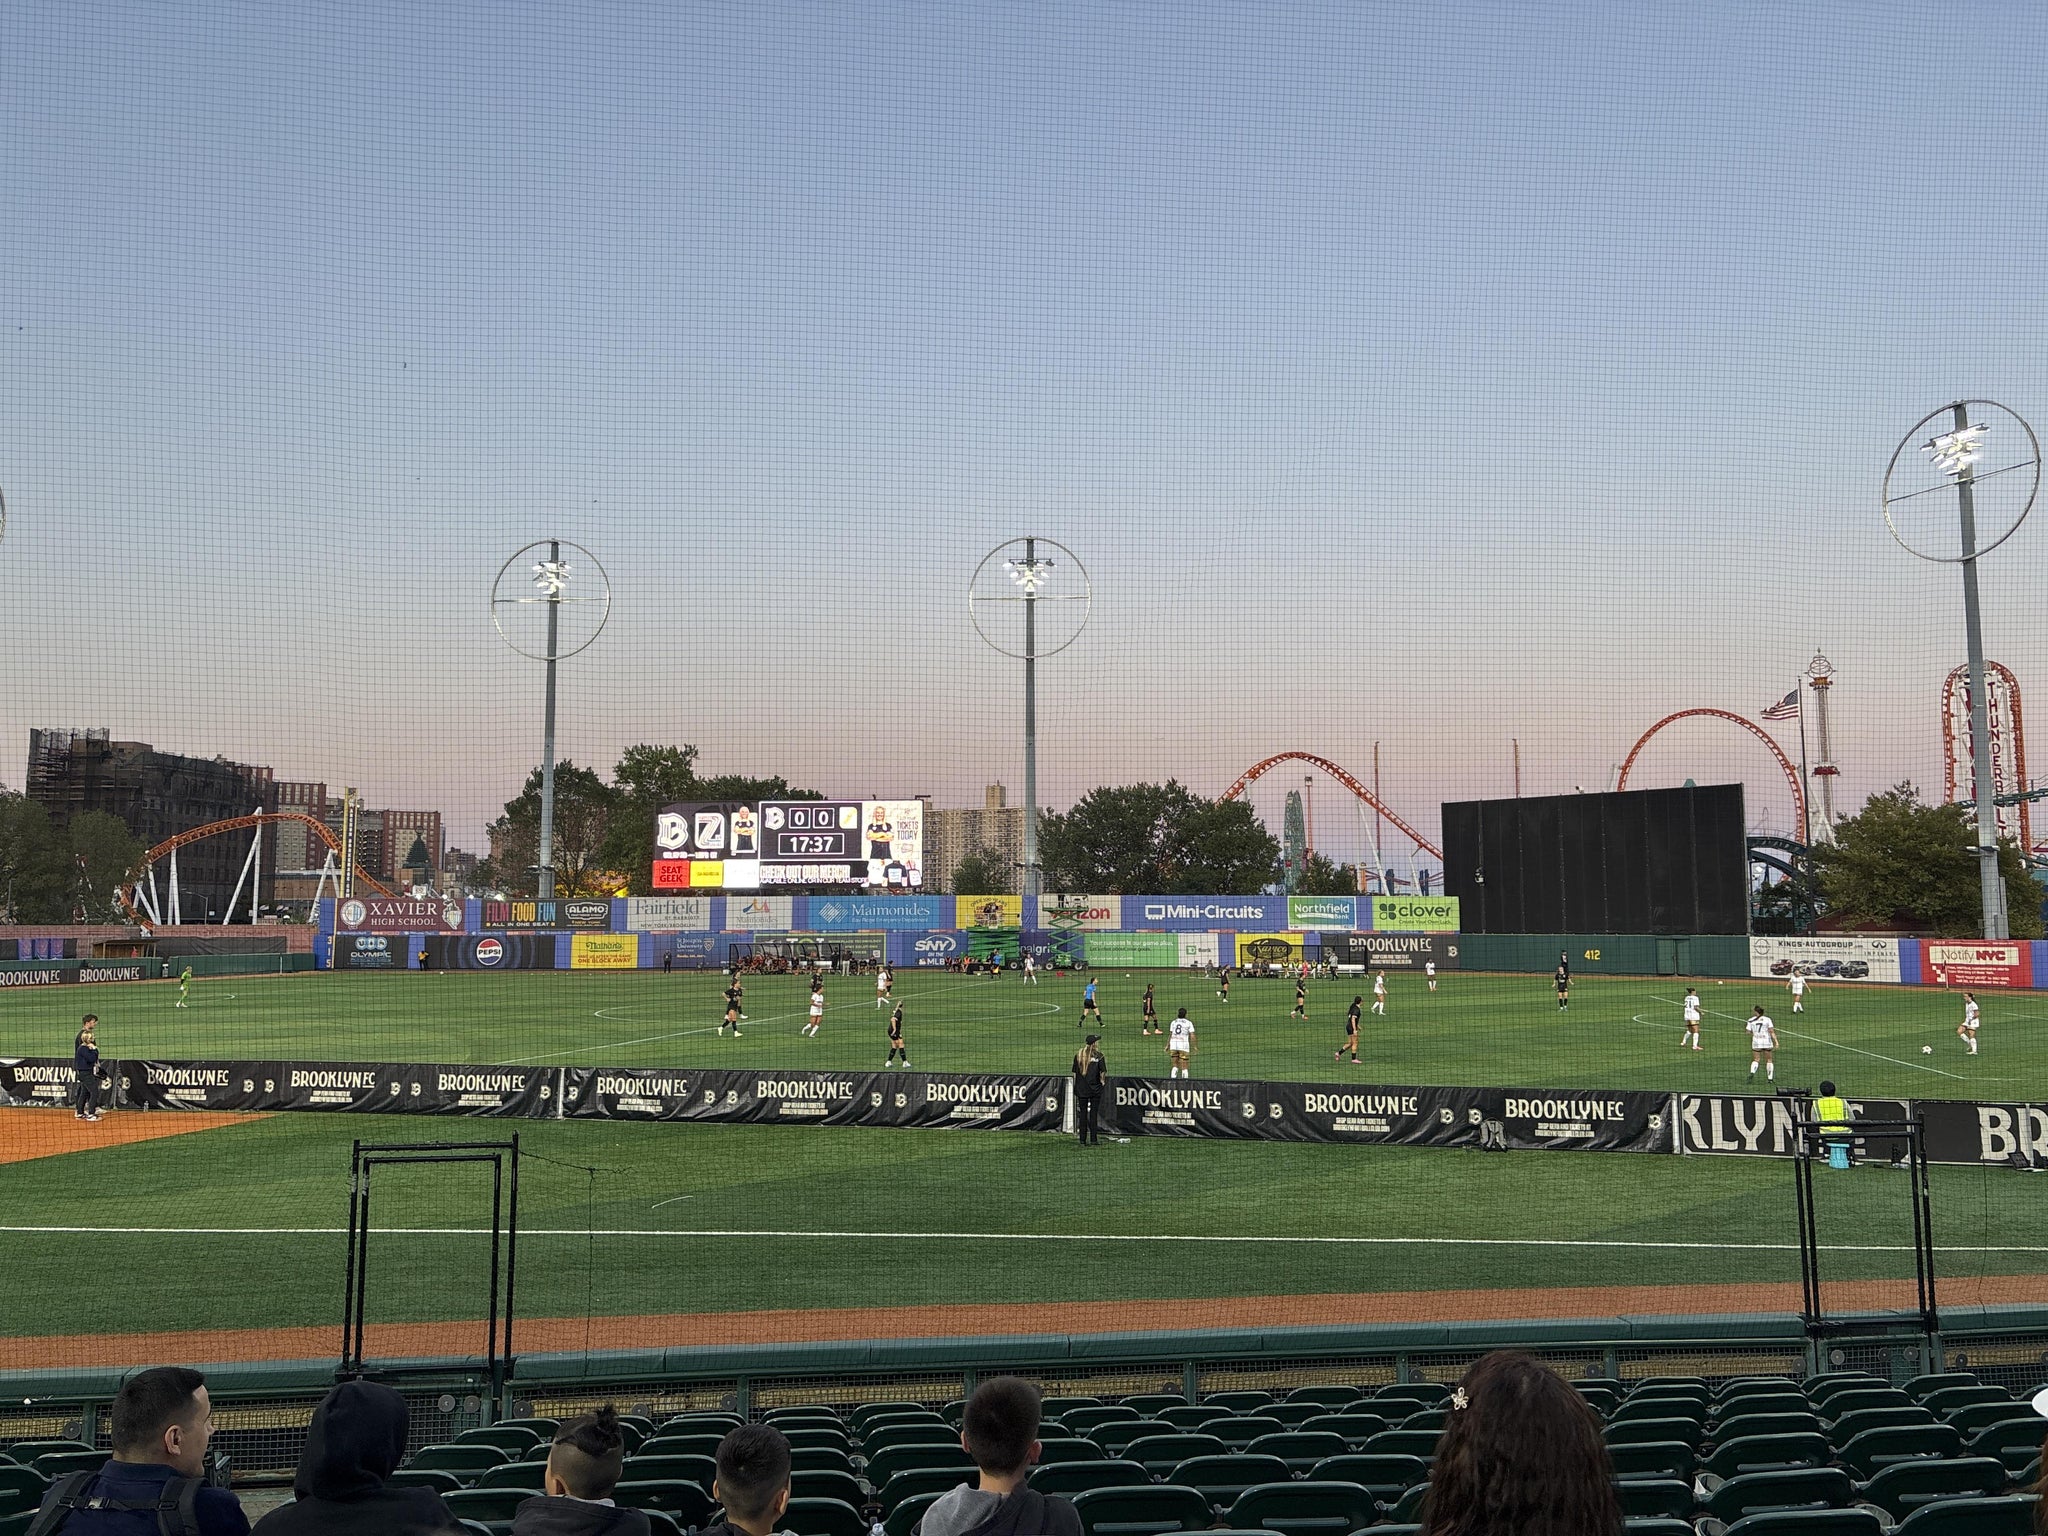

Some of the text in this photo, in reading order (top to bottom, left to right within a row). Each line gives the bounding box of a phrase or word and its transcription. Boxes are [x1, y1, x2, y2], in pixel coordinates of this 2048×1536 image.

[1987, 682, 2007, 837] THUNDERBLT
[794, 812, 804, 825] 0
[818, 812, 829, 825] 0
[897, 821, 918, 830] TICKETS
[897, 831, 918, 840] TODAY
[790, 837, 833, 852] 17:37
[661, 866, 682, 874] SEAT
[760, 865, 785, 878] CHECK
[786, 865, 802, 878] OUT
[803, 865, 819, 878] OUR
[660, 874, 682, 882] GEEK
[370, 902, 438, 916] XAVIER
[486, 902, 555, 921] FILM FOOD FUN
[636, 899, 699, 915] Fairfield
[852, 903, 930, 916] Maimonides
[1168, 905, 1264, 919] Mini-Circuits
[1295, 904, 1349, 913] Northfield
[1398, 903, 1450, 917] clover
[371, 918, 436, 926] HIGH SCHOOL
[586, 941, 622, 950] Nathan's
[915, 937, 951, 951] SNY
[1349, 938, 1432, 951] BROOKLYN FC
[1584, 949, 1601, 960] 412
[1941, 949, 2006, 963] Notify NYC
[0, 970, 60, 986] ROOKLYN FC
[80, 967, 140, 982] BROOKLYN FC
[1175, 1024, 1182, 1034] 8
[14, 1067, 77, 1083] BROOKLYN
[147, 1069, 229, 1086] BROOKLYN FC
[291, 1070, 375, 1088] BROOKLYN FC
[438, 1074, 525, 1091] BROOKLYN FC
[597, 1077, 687, 1096] BROOKLYN FC
[757, 1080, 853, 1099] BROOKLYN FC
[927, 1084, 1026, 1102] BROOKLYN FC
[1116, 1087, 1221, 1109] BROOKLYN FC
[1304, 1093, 1418, 1115] BROOKLYN FC
[1505, 1099, 1624, 1120] BROOKLYN FC
